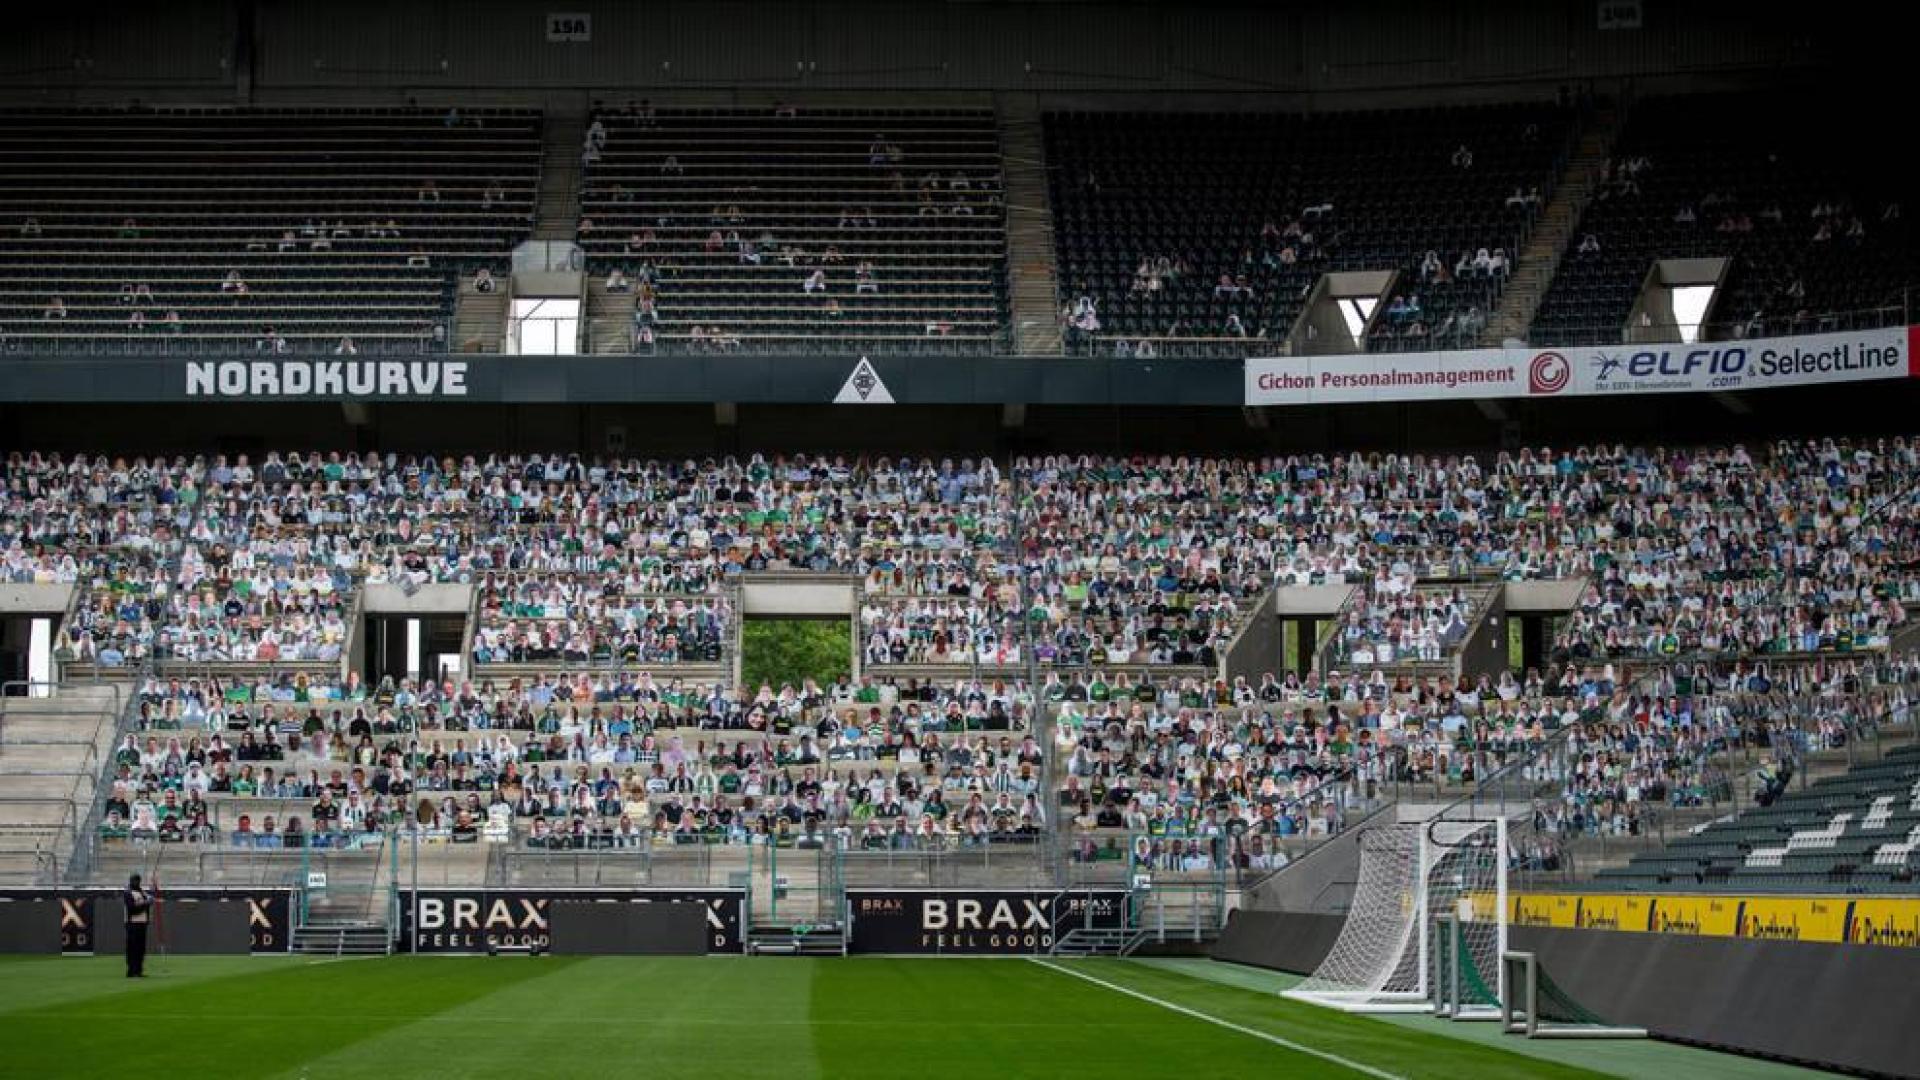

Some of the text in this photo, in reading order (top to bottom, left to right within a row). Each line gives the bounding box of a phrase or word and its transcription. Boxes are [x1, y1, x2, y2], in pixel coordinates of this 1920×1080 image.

[1760, 342, 1899, 377] SelectLine
[186, 361, 468, 395] NORDKURVE
[1258, 366, 1515, 391] Cichon Personalmanagement
[1706, 375, 1741, 388] .com
[420, 898, 548, 929] BRAX
[862, 899, 903, 911] BRAX
[923, 899, 1050, 929] BRAX
[419, 934, 474, 947] FEEL
[922, 934, 1052, 947] FEEL GOOD
